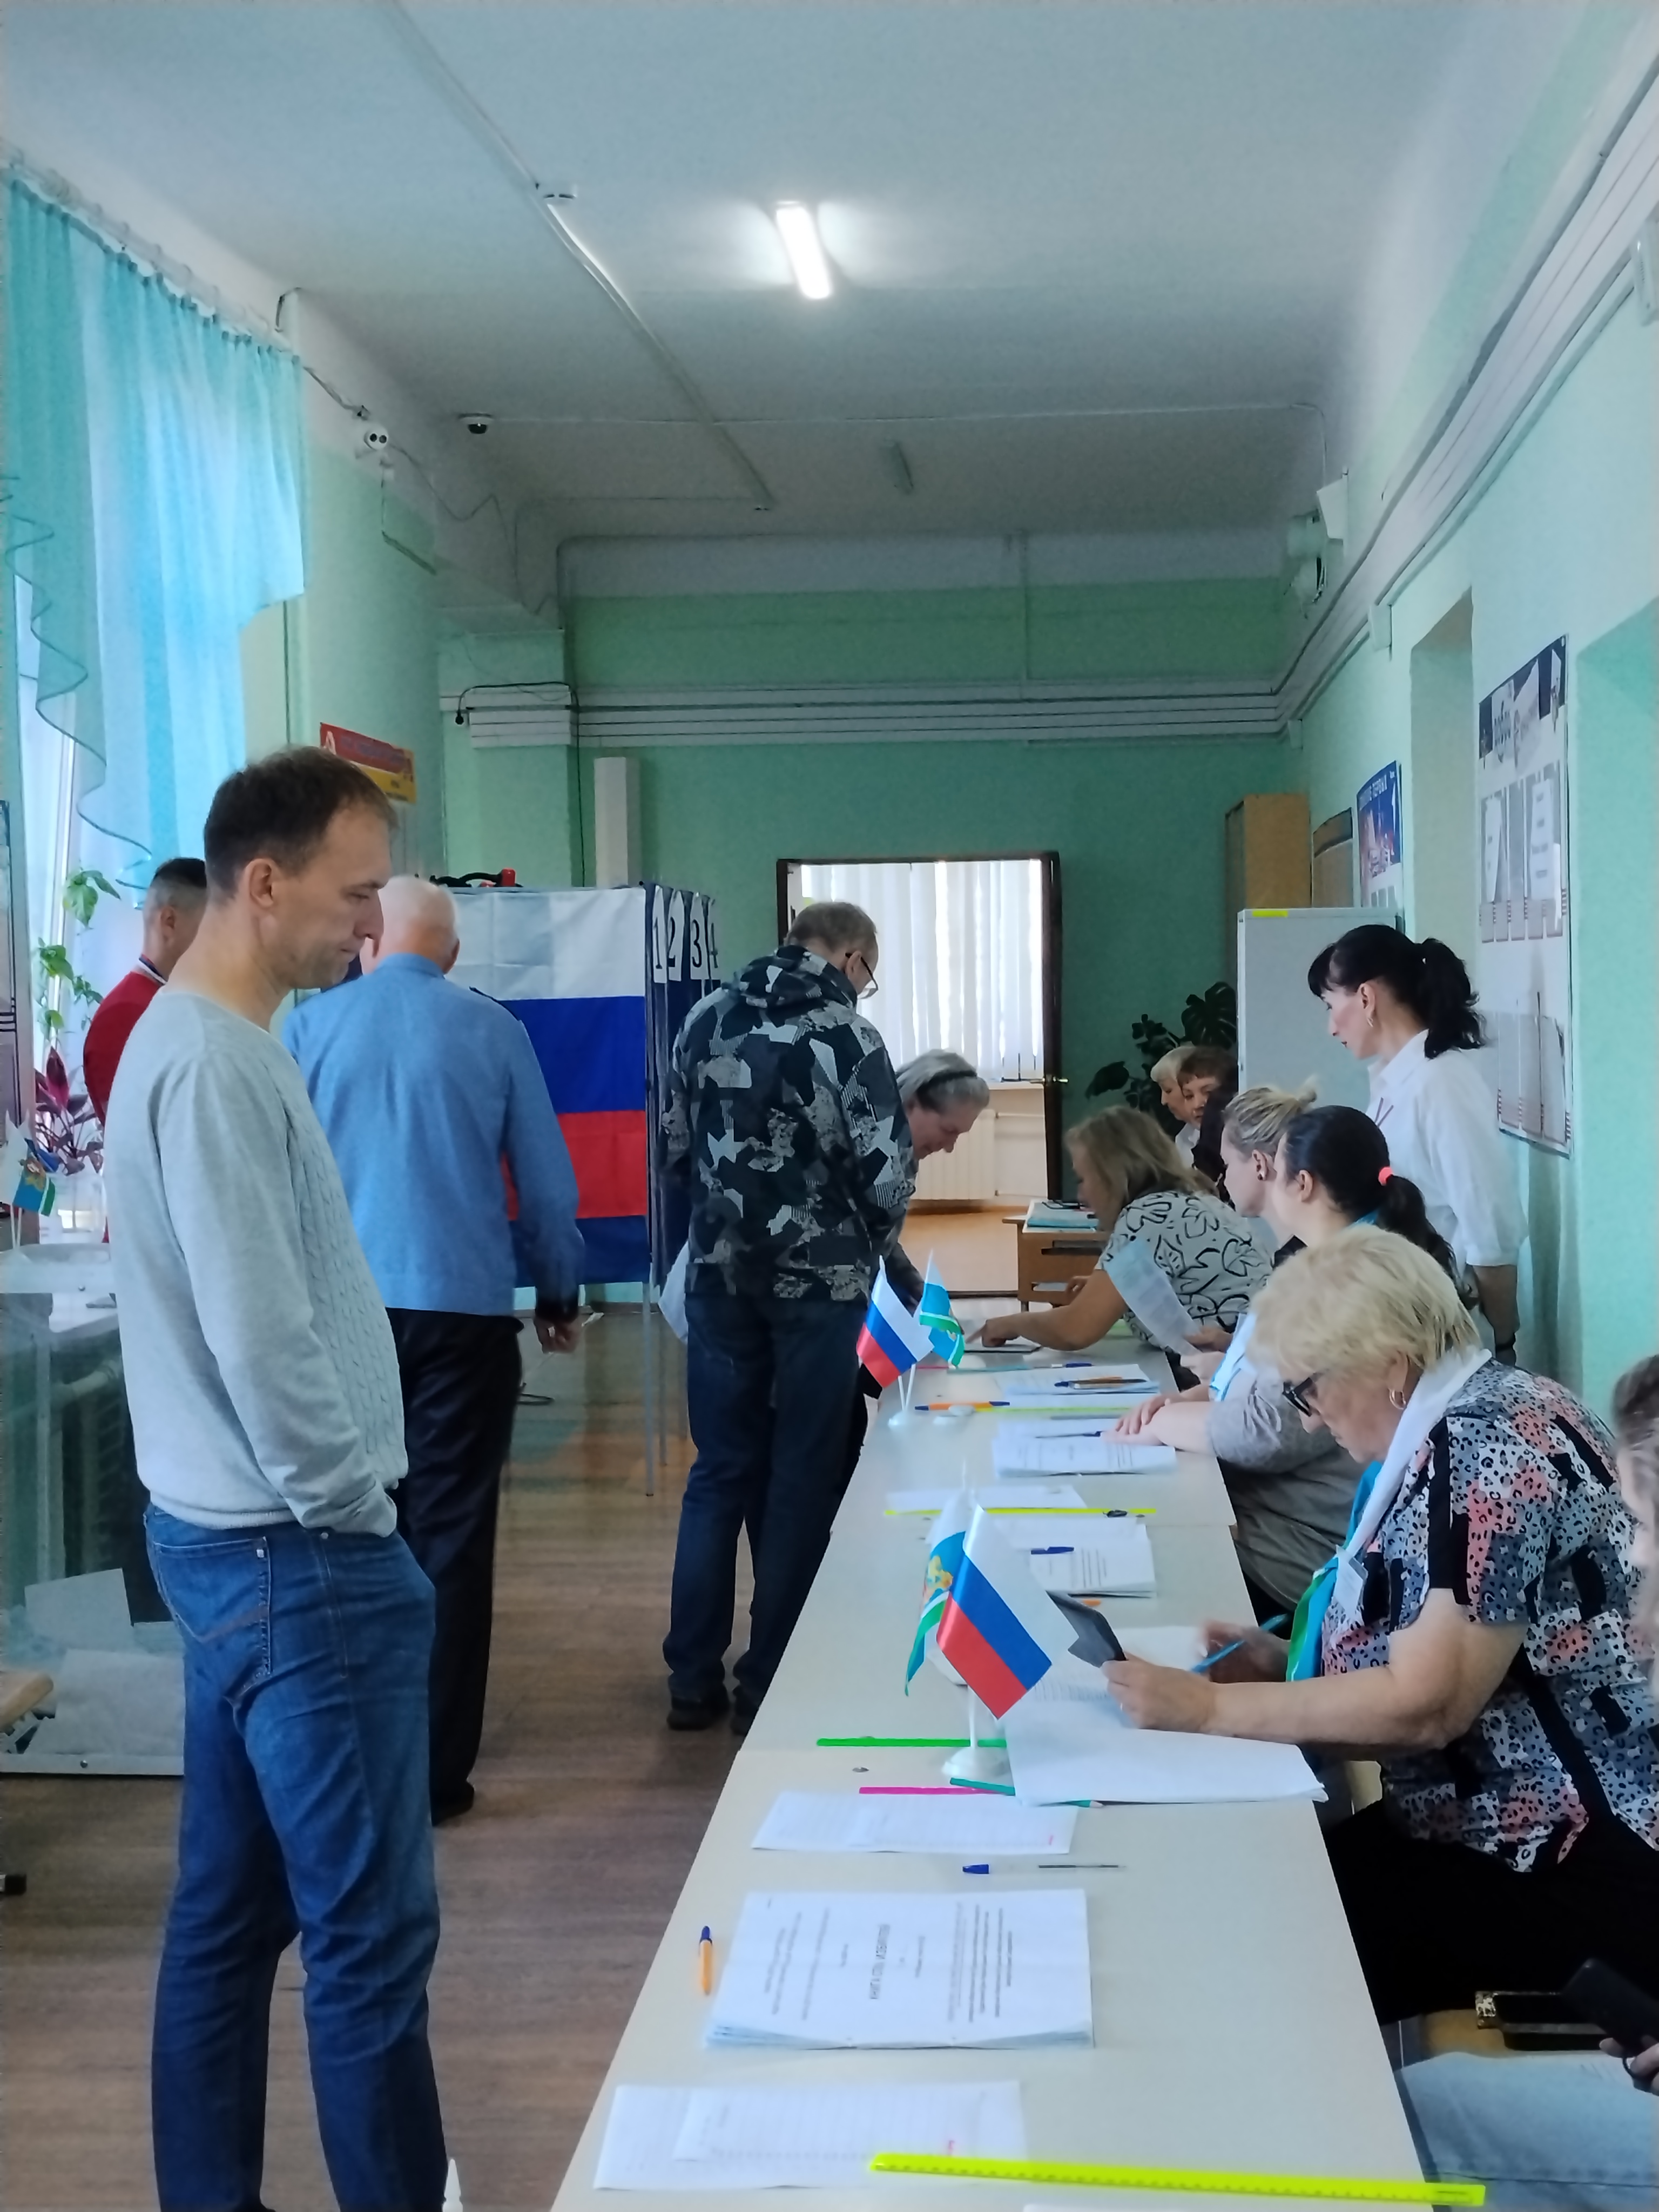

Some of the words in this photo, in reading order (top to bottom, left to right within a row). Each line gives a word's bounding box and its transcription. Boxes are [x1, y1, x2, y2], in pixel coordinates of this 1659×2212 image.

[653, 917, 663, 969] 1
[668, 916, 676, 967] 2
[691, 919, 702, 968] 3
